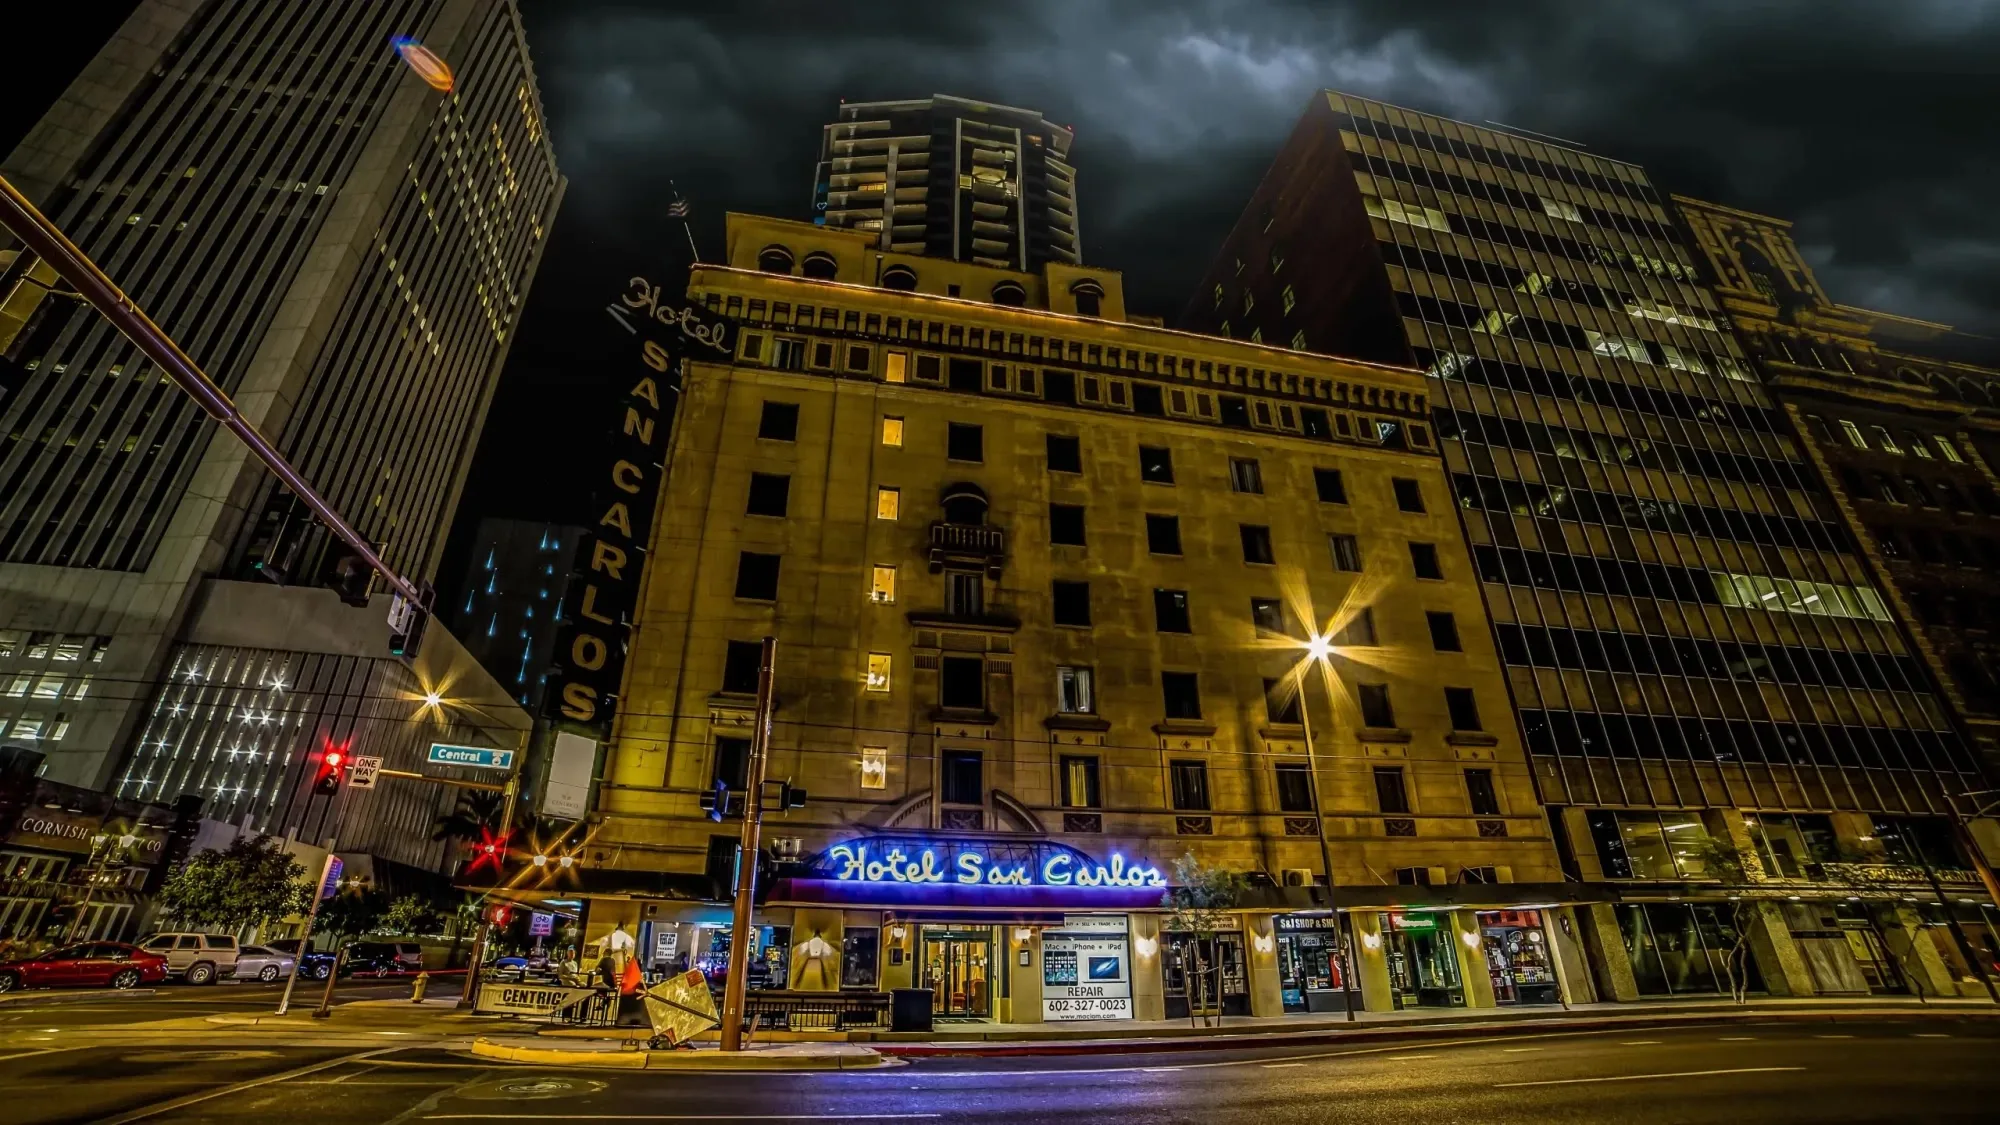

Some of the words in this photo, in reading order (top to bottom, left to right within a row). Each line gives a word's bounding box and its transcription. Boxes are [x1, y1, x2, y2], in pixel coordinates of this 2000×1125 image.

[622, 276, 731, 353] Hotel
[623, 340, 669, 445] SAN
[560, 459, 643, 721] CARLOS
[437, 748, 481, 762] Central
[358, 758, 377, 768] ONE
[355, 767, 376, 777] WAY
[22, 817, 89, 841] CORNISH
[147, 840, 161, 852] CO
[830, 846, 944, 883] Hotel
[957, 852, 1032, 885] San
[1042, 853, 1168, 887] Carlos
[1295, 918, 1315, 928] SHOP
[1315, 920, 1322, 928] &
[1072, 943, 1095, 951] iPhone
[1067, 986, 1104, 997] REPAIR
[1048, 1000, 1126, 1011] 602-327-0023
